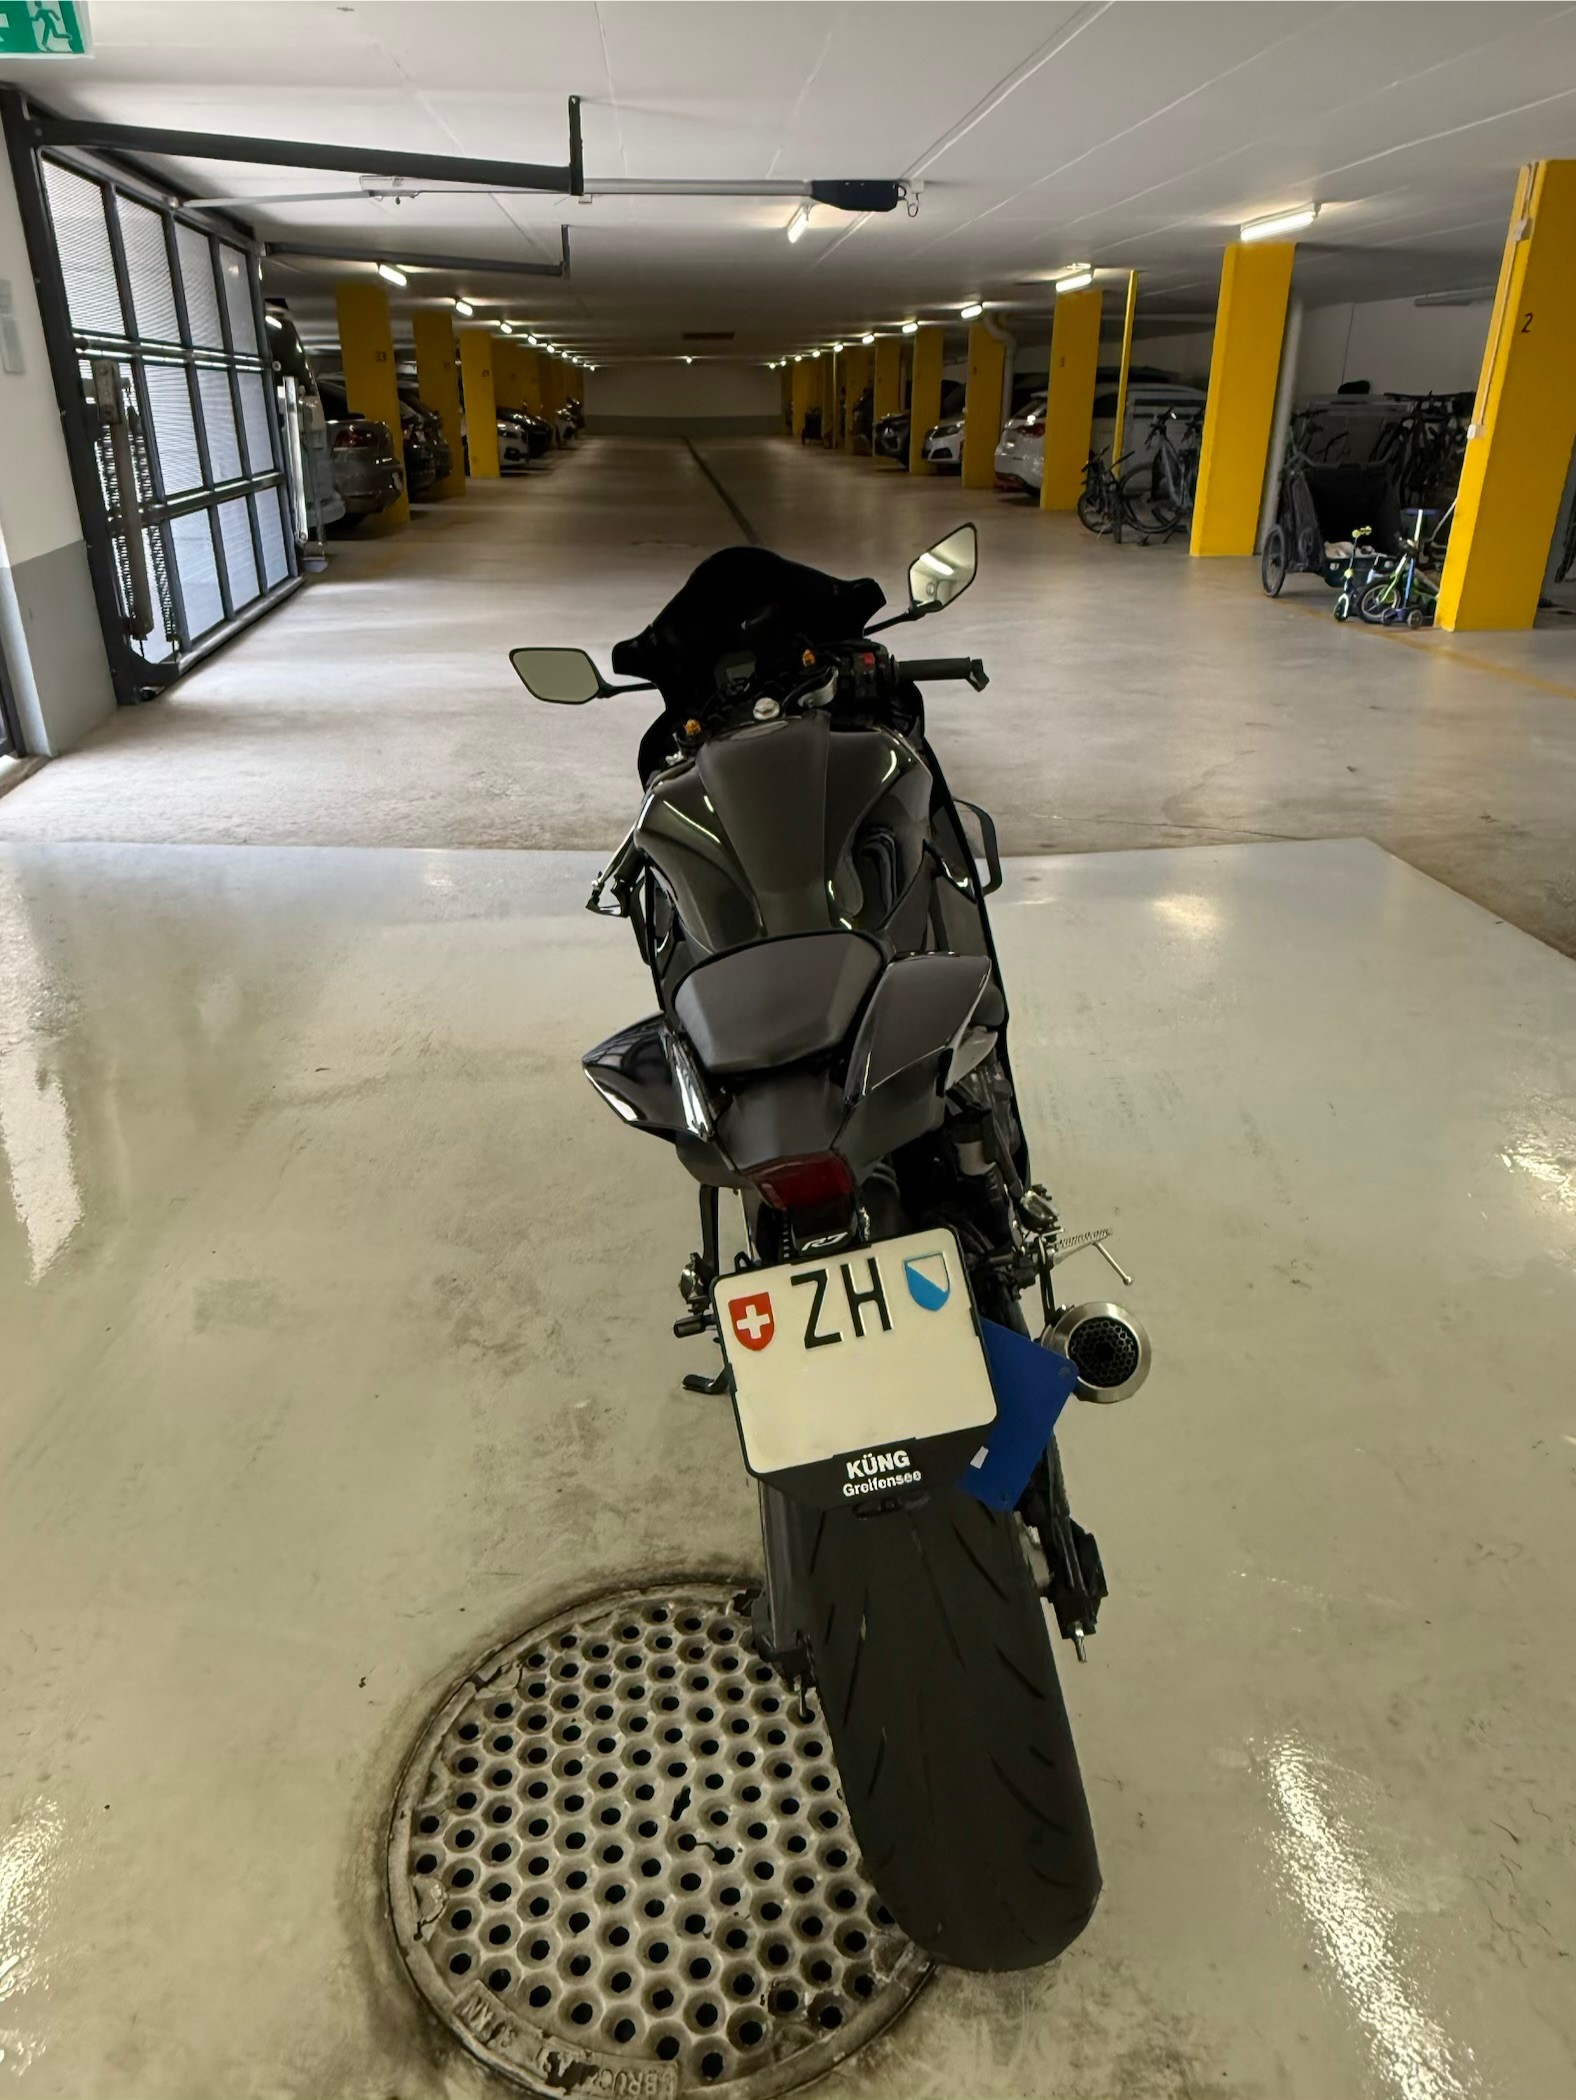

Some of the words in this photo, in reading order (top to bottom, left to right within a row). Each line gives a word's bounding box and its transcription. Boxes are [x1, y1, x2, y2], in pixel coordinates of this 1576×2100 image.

[1520, 312, 1533, 334] 2
[801, 1231, 849, 1251] R7
[790, 1256, 894, 1349] ZH
[845, 1449, 911, 1480] KÜNG
[842, 1470, 922, 1498] Greifensee
